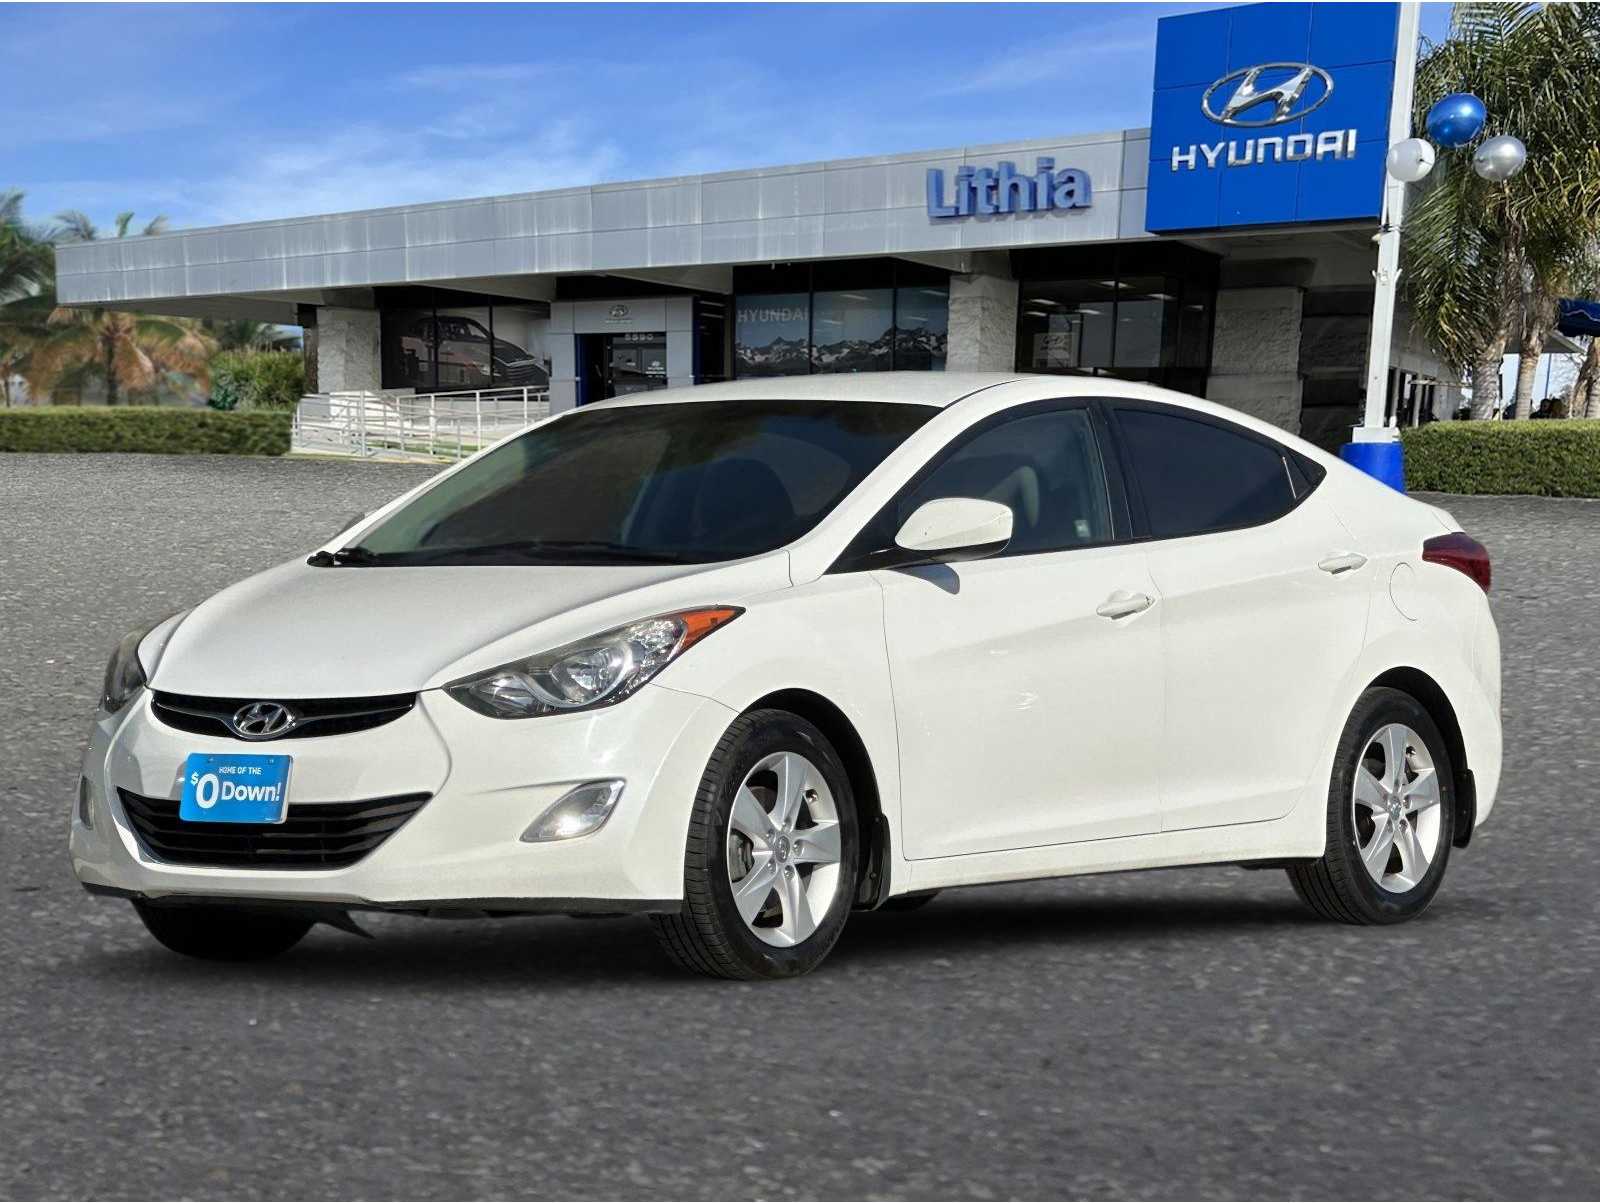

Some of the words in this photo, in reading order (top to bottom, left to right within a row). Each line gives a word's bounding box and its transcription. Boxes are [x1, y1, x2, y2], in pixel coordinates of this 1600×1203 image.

[1171, 129, 1357, 172] HYUNDAI
[927, 157, 1092, 217] Lithia
[737, 307, 809, 322] HYUNDAI
[219, 766, 236, 774] HOME
[249, 767, 262, 775] THE
[221, 782, 281, 802] Down!
